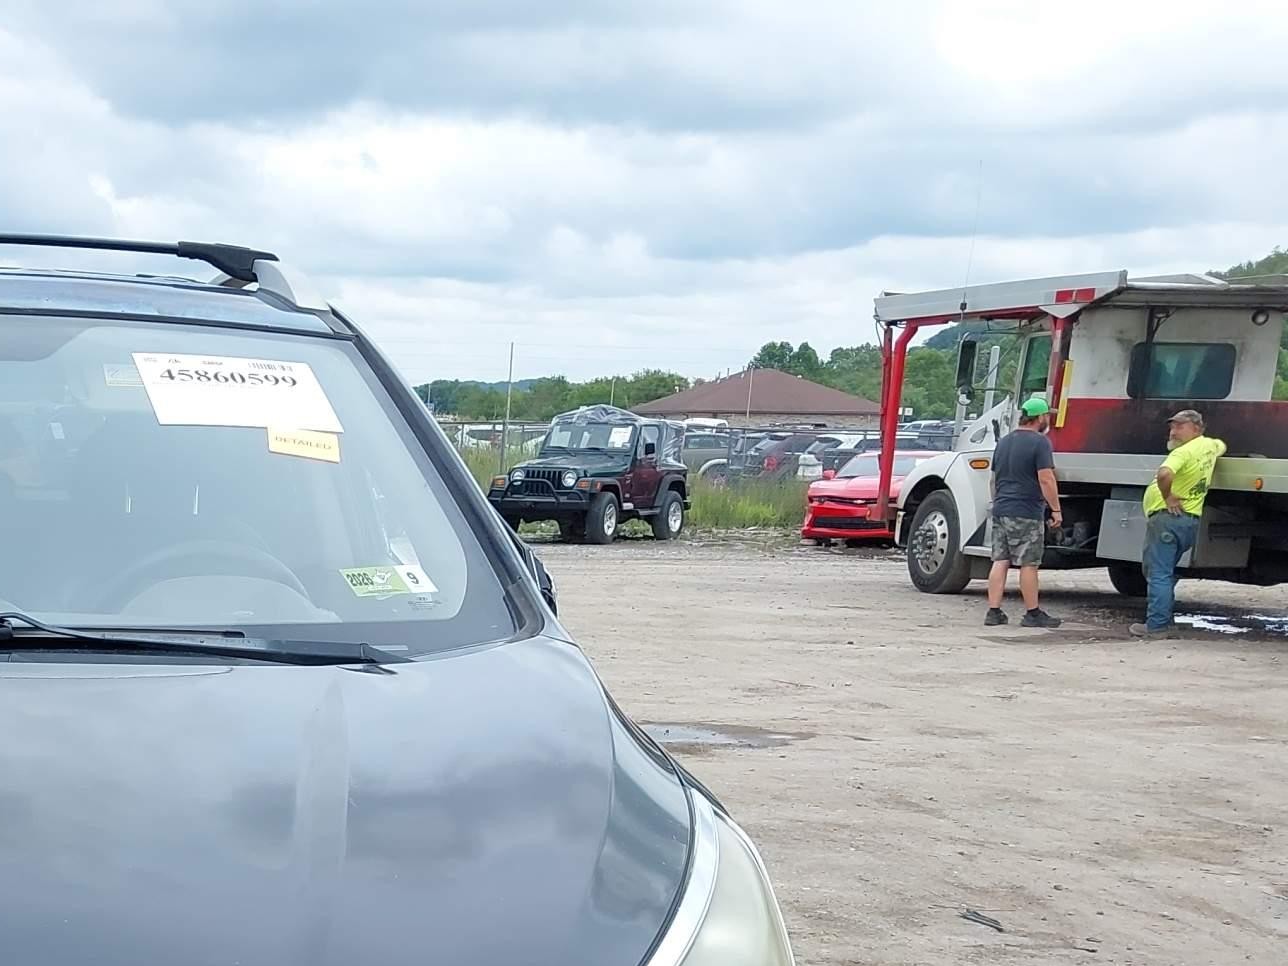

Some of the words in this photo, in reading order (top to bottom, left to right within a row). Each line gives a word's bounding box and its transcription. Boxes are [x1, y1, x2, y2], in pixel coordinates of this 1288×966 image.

[159, 368, 298, 388] 45860599
[346, 572, 374, 587] 2026
[406, 571, 420, 585] 9
